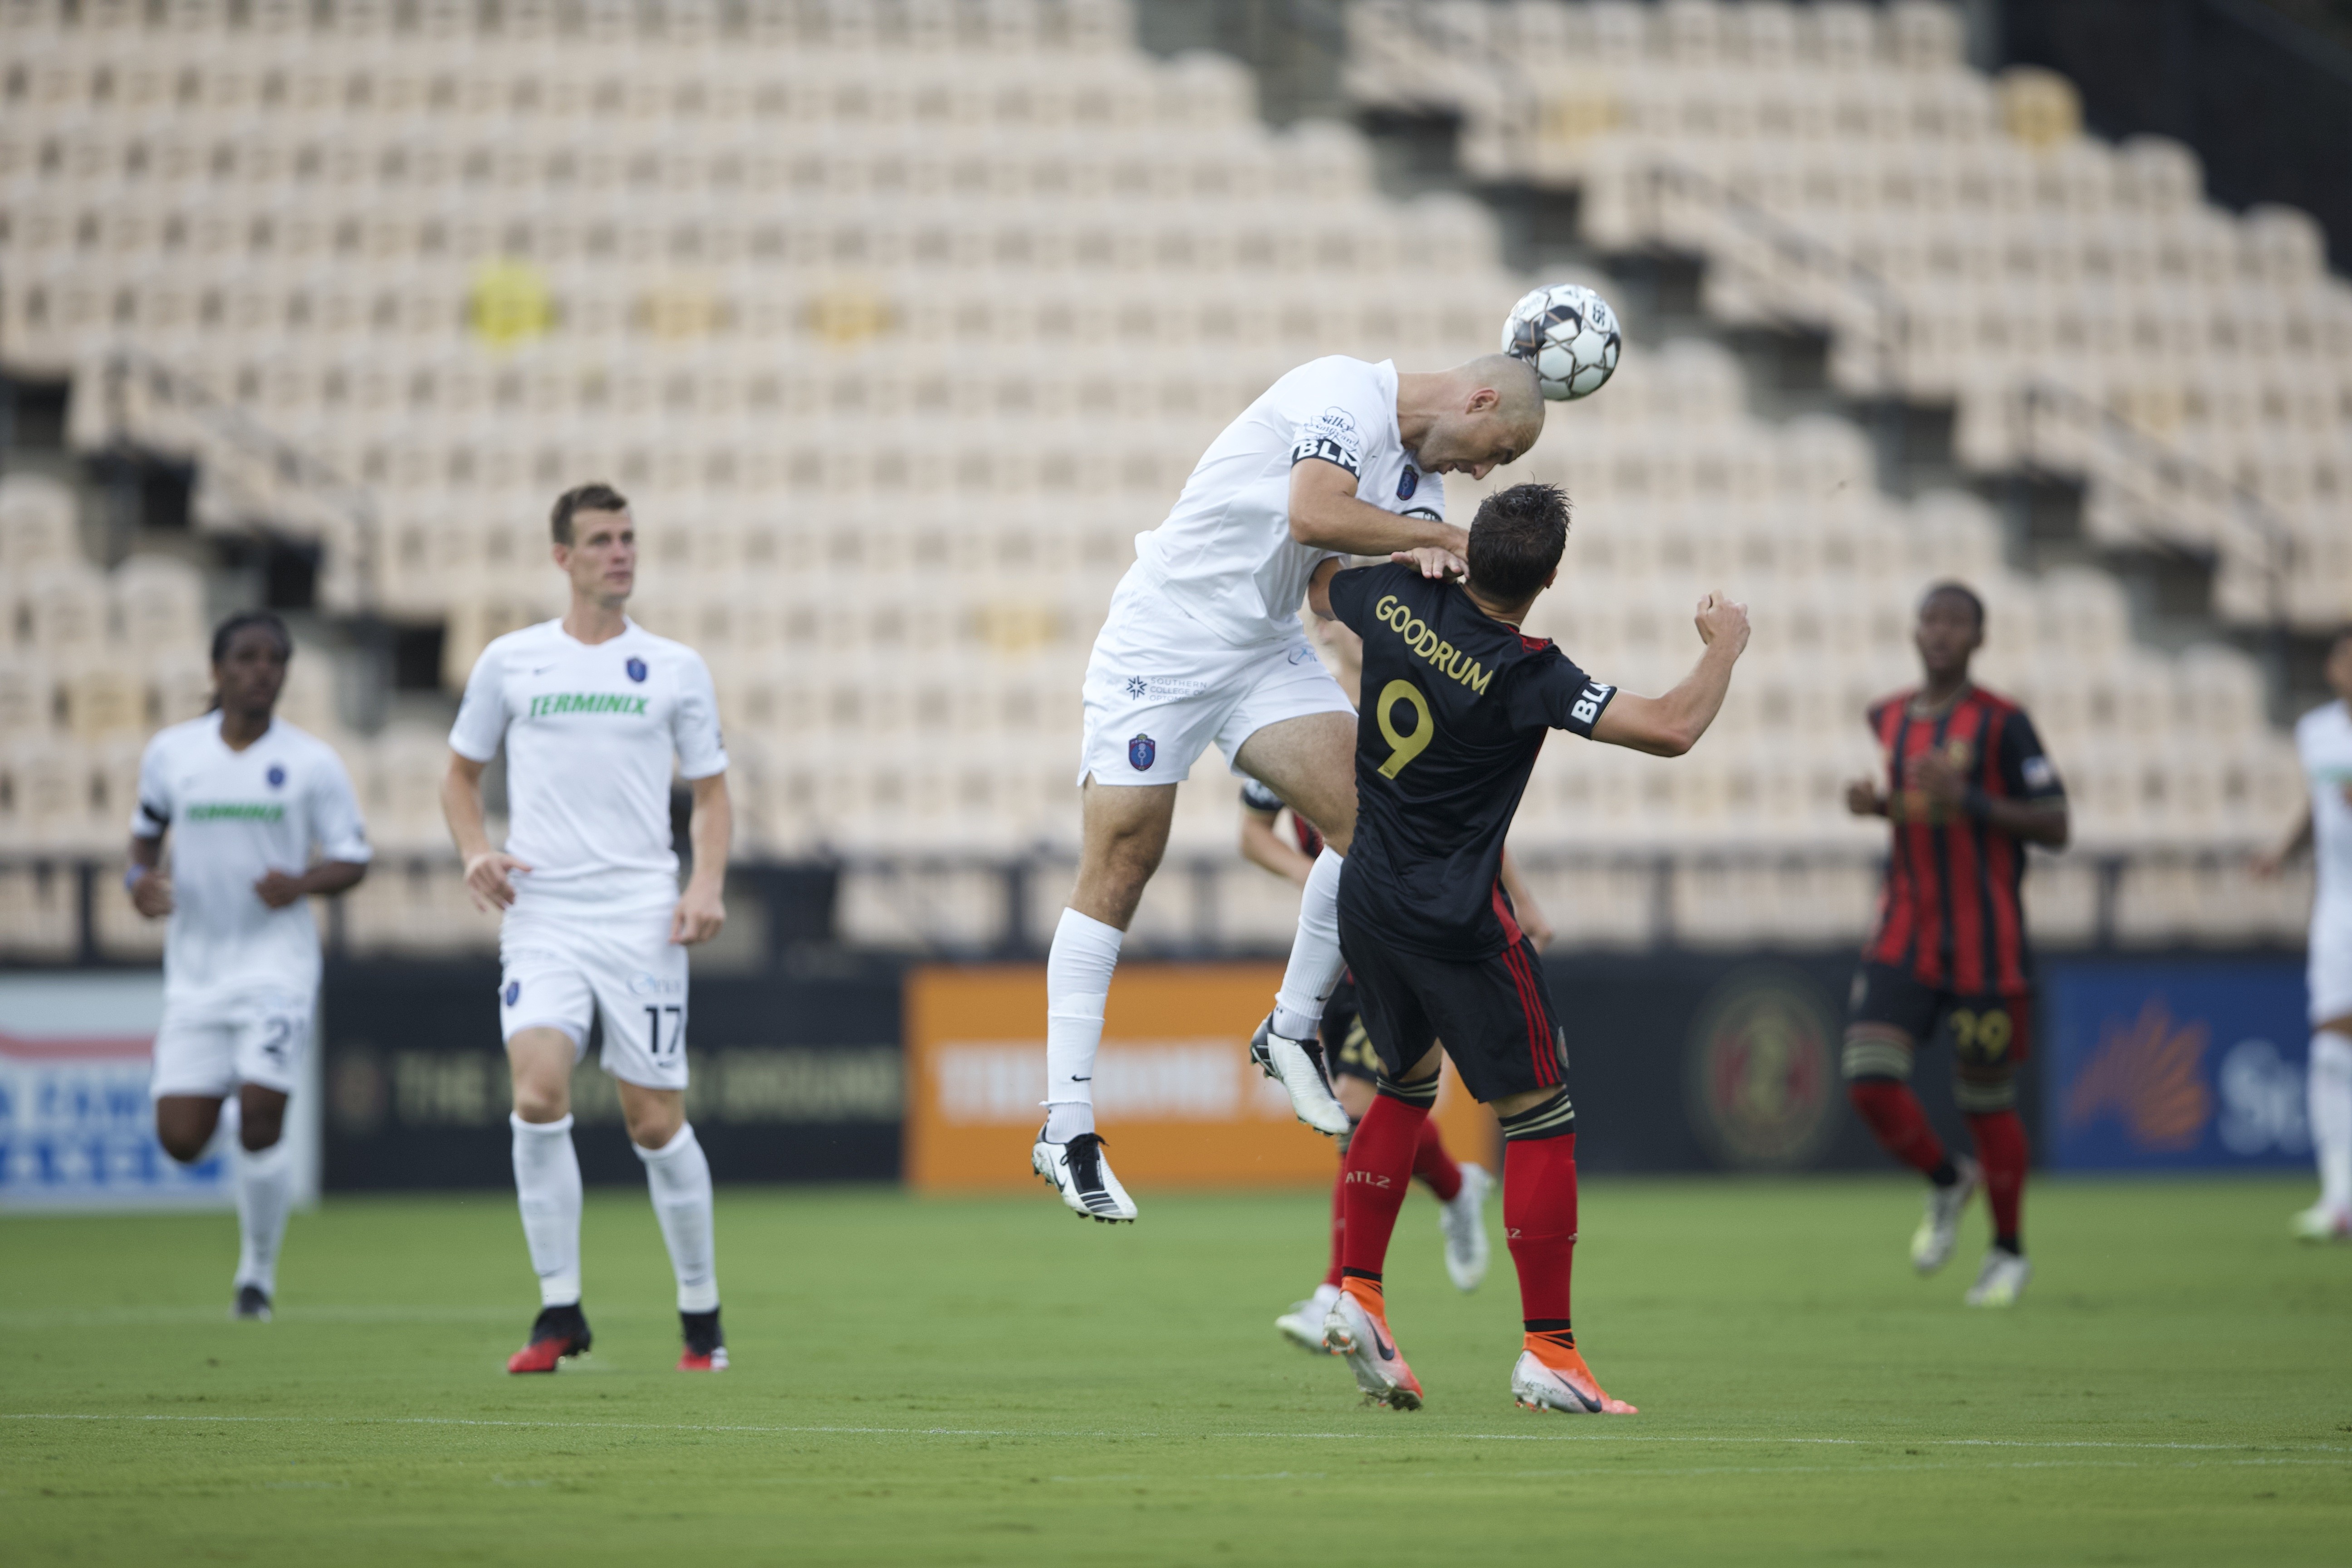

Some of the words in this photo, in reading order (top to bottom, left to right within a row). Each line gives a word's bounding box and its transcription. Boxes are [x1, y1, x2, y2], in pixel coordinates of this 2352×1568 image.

[1322, 415, 1354, 433] Silky
[1297, 439, 1361, 478] BLM
[1376, 595, 1494, 696] GOODRUM
[1150, 686, 1190, 695] COLLEGE
[1151, 677, 1207, 689] SOUTHERN
[530, 692, 651, 718] TERMINIX
[1377, 679, 1434, 780] 9
[644, 1004, 682, 1054] 17
